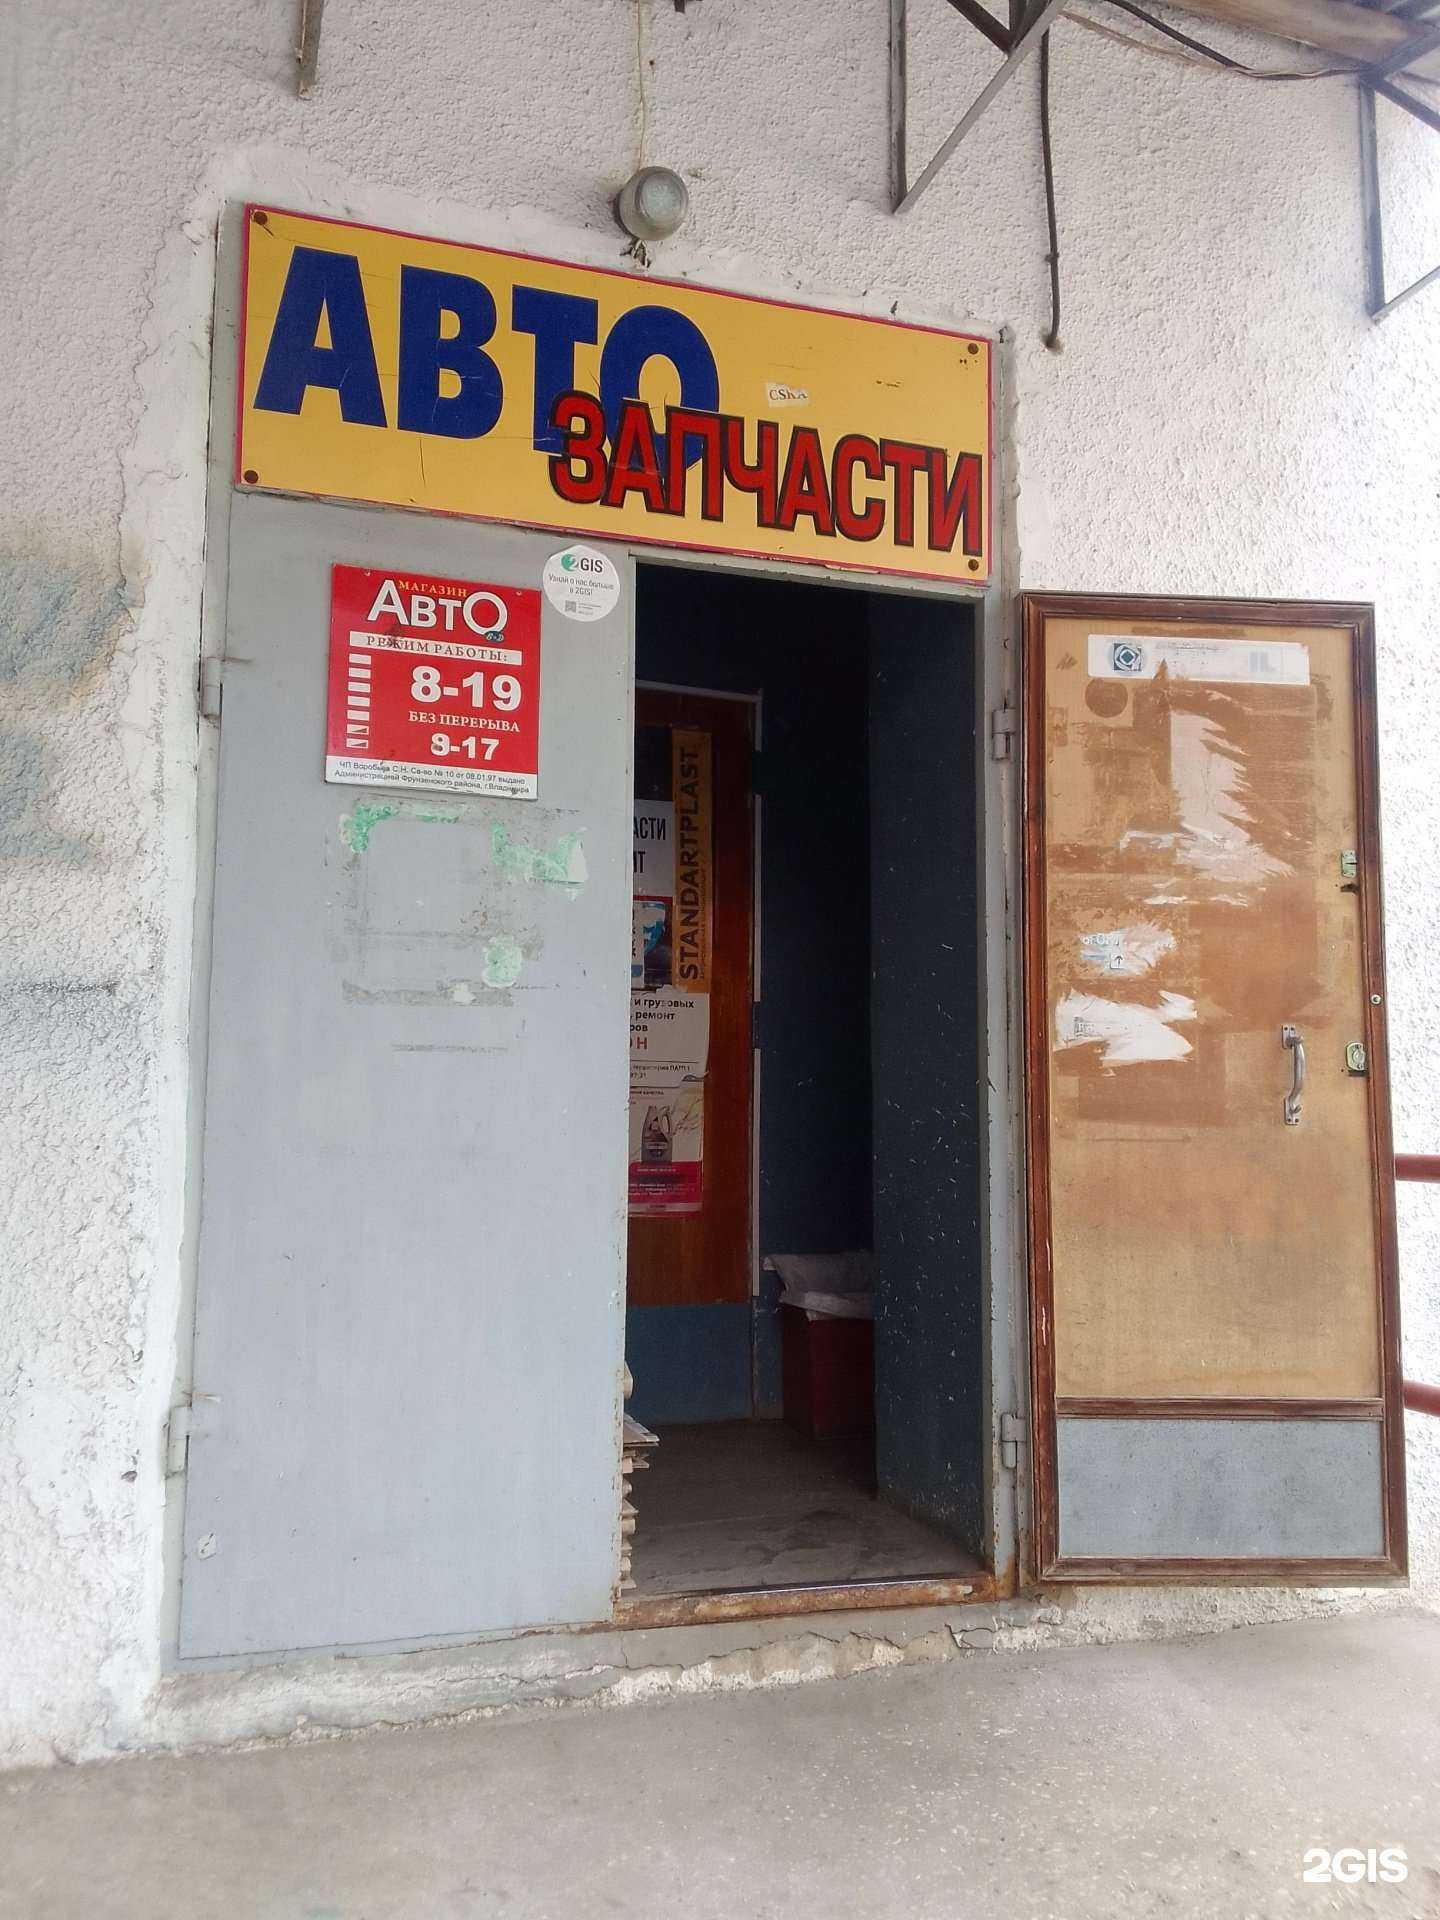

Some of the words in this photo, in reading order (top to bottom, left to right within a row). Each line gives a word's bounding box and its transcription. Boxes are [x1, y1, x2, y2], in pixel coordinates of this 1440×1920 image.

[253, 245, 720, 474] АВТО
[548, 389, 983, 556] ЗАПЧАСТИ
[398, 580, 468, 598] МАГАЗИН
[367, 635, 429, 652] РЕЖИМ
[434, 643, 508, 662] РАБОТЫ:
[411, 665, 522, 711] 8-19
[408, 710, 436, 724] БЕЗ
[440, 713, 521, 733] ПЕРЕРЫВА
[430, 732, 500, 761] 8-17
[679, 746, 699, 980] STANDARTPLAST
[636, 1011, 675, 1021] ремонт
